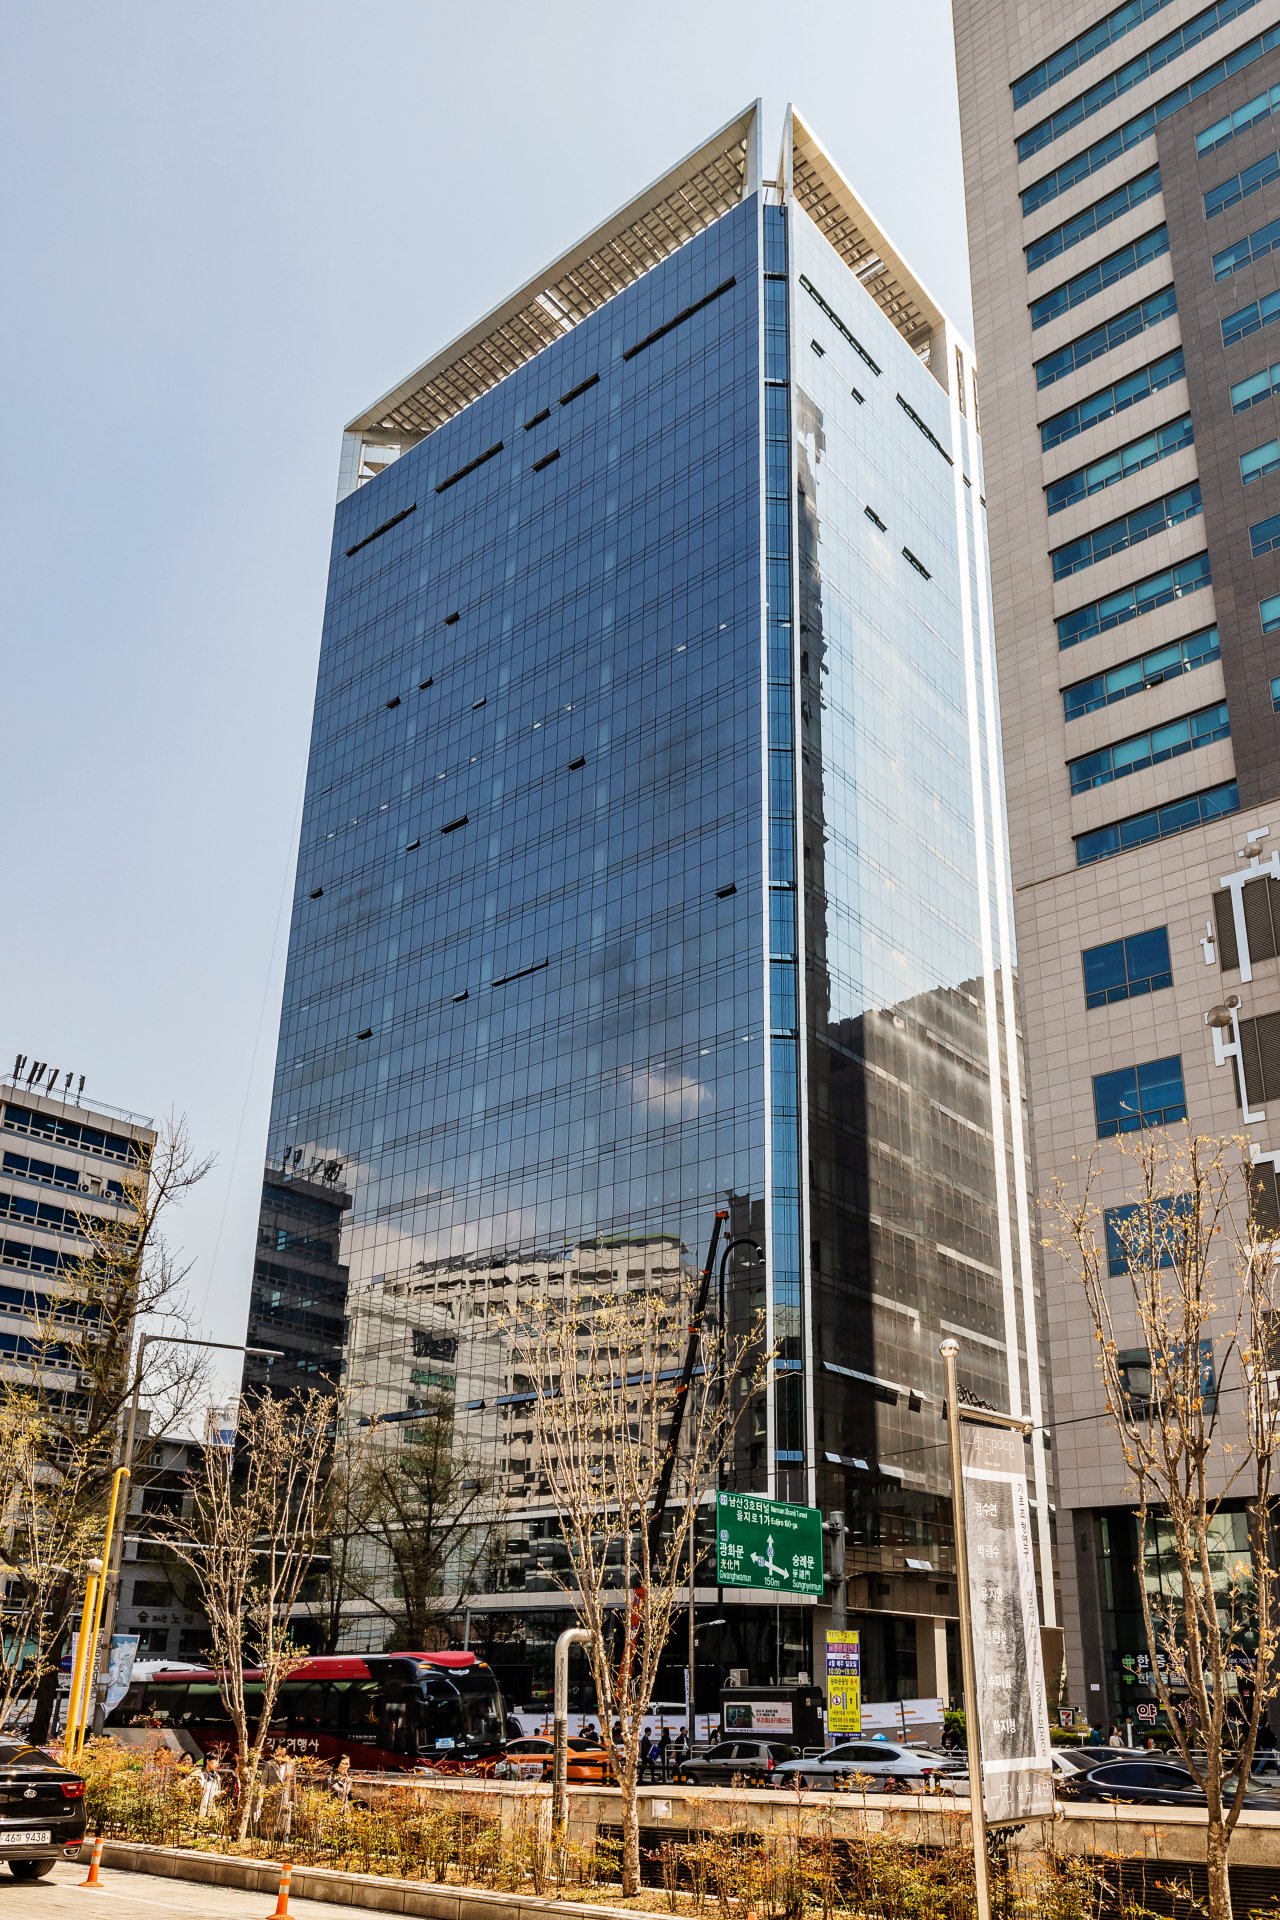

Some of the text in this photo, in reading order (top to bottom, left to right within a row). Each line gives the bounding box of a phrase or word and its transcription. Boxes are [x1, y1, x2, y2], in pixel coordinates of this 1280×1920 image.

[729, 1496, 770, 1514] 남산3호터널
[975, 1502, 997, 1517] 김수연
[736, 1509, 770, 1526] 을지로1가
[720, 1542, 744, 1560] 광화문
[977, 1544, 1000, 1559] 박광수
[720, 1558, 740, 1571] 光化門
[792, 1554, 815, 1570] 숭례문
[719, 1569, 752, 1583] Gwanghwamun
[764, 1577, 780, 1588] 150m
[792, 1578, 822, 1591] Sungnyemun
[980, 1586, 1003, 1602] 유지영
[984, 1630, 1007, 1644] 전현선
[1136, 1703, 1157, 1725] 약
[1037, 1719, 1047, 1757] space
[25, 1832, 46, 1842] 9438
